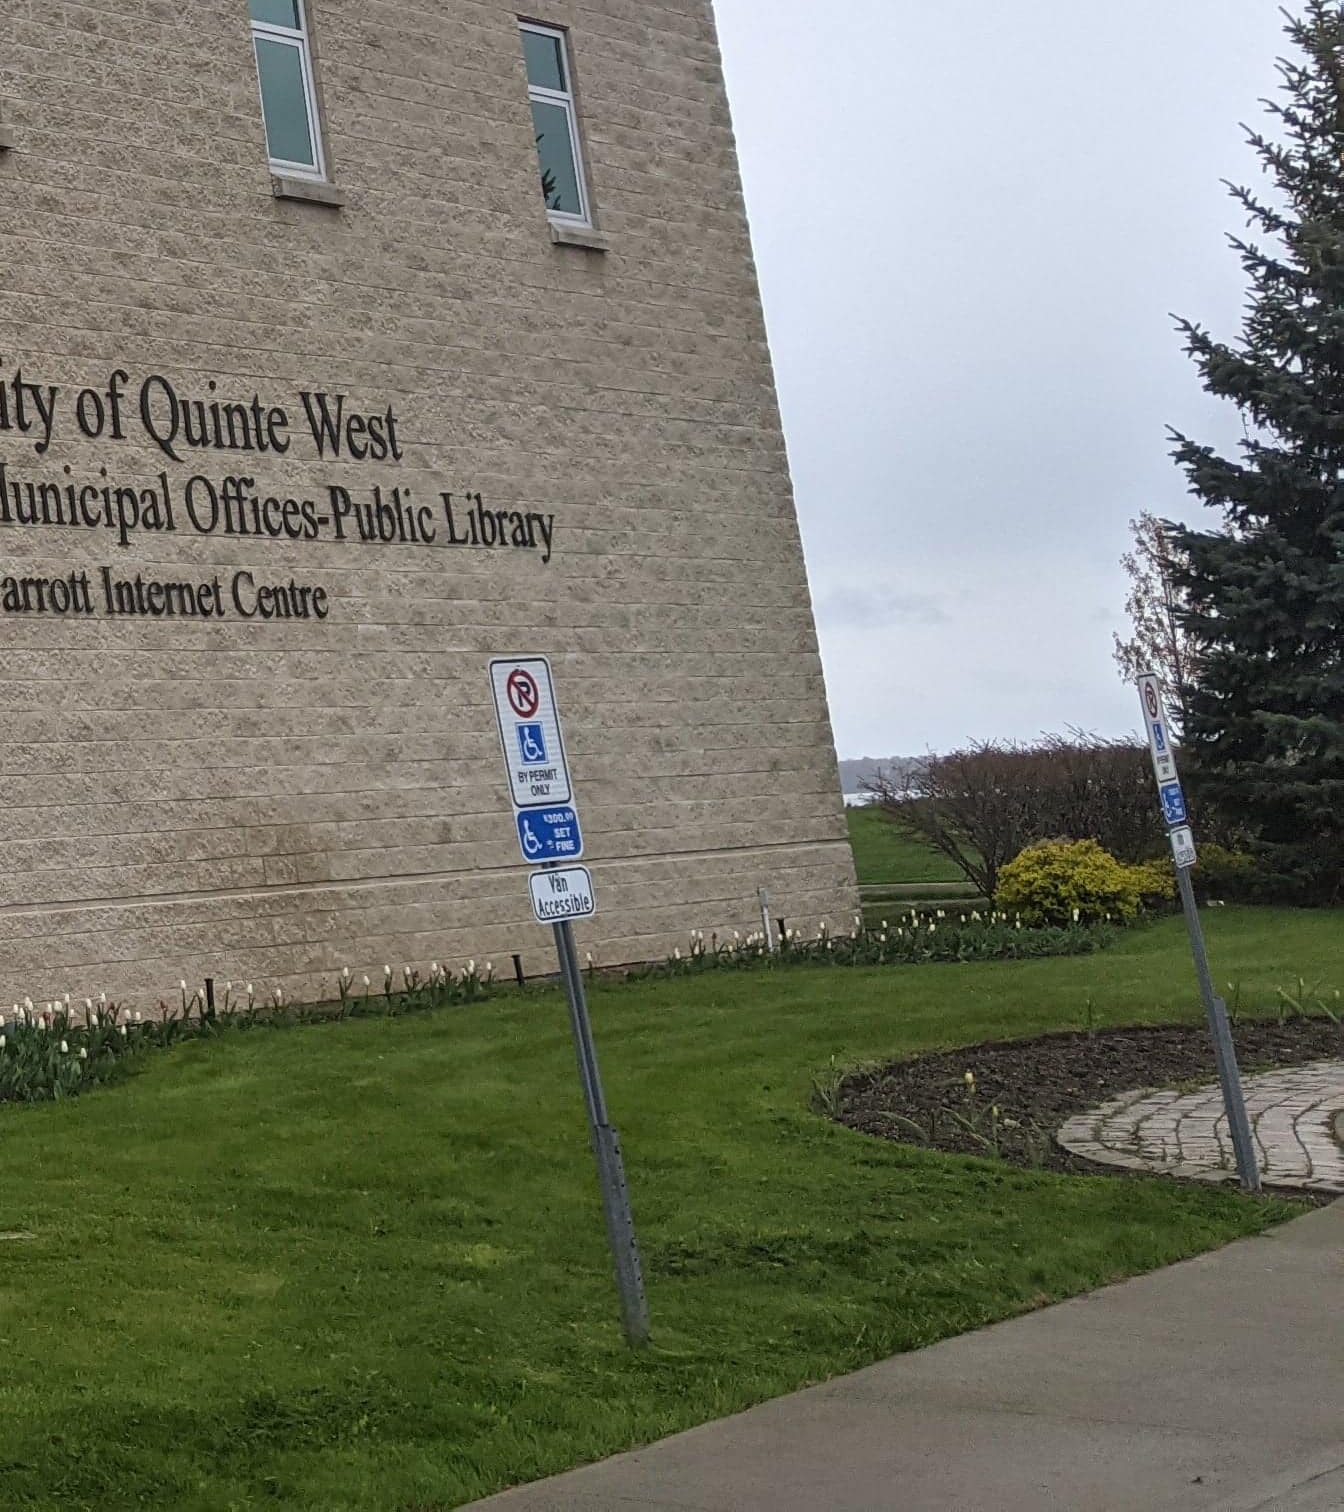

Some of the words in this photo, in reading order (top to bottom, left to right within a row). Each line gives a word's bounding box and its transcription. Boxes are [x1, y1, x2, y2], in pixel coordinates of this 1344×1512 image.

[76, 369, 129, 439] of
[140, 374, 291, 463] Quinte
[299, 391, 404, 461] West
[440, 492, 555, 564] Library
[101, 566, 225, 618] Internet
[232, 570, 329, 619] Centre
[518, 771, 528, 783] BY
[529, 769, 558, 782] PERMIT
[531, 784, 550, 796] ONLY
[554, 827, 570, 838] SET
[555, 840, 575, 852] FINE
[548, 874, 569, 893] Van
[538, 892, 589, 917] Accessible
